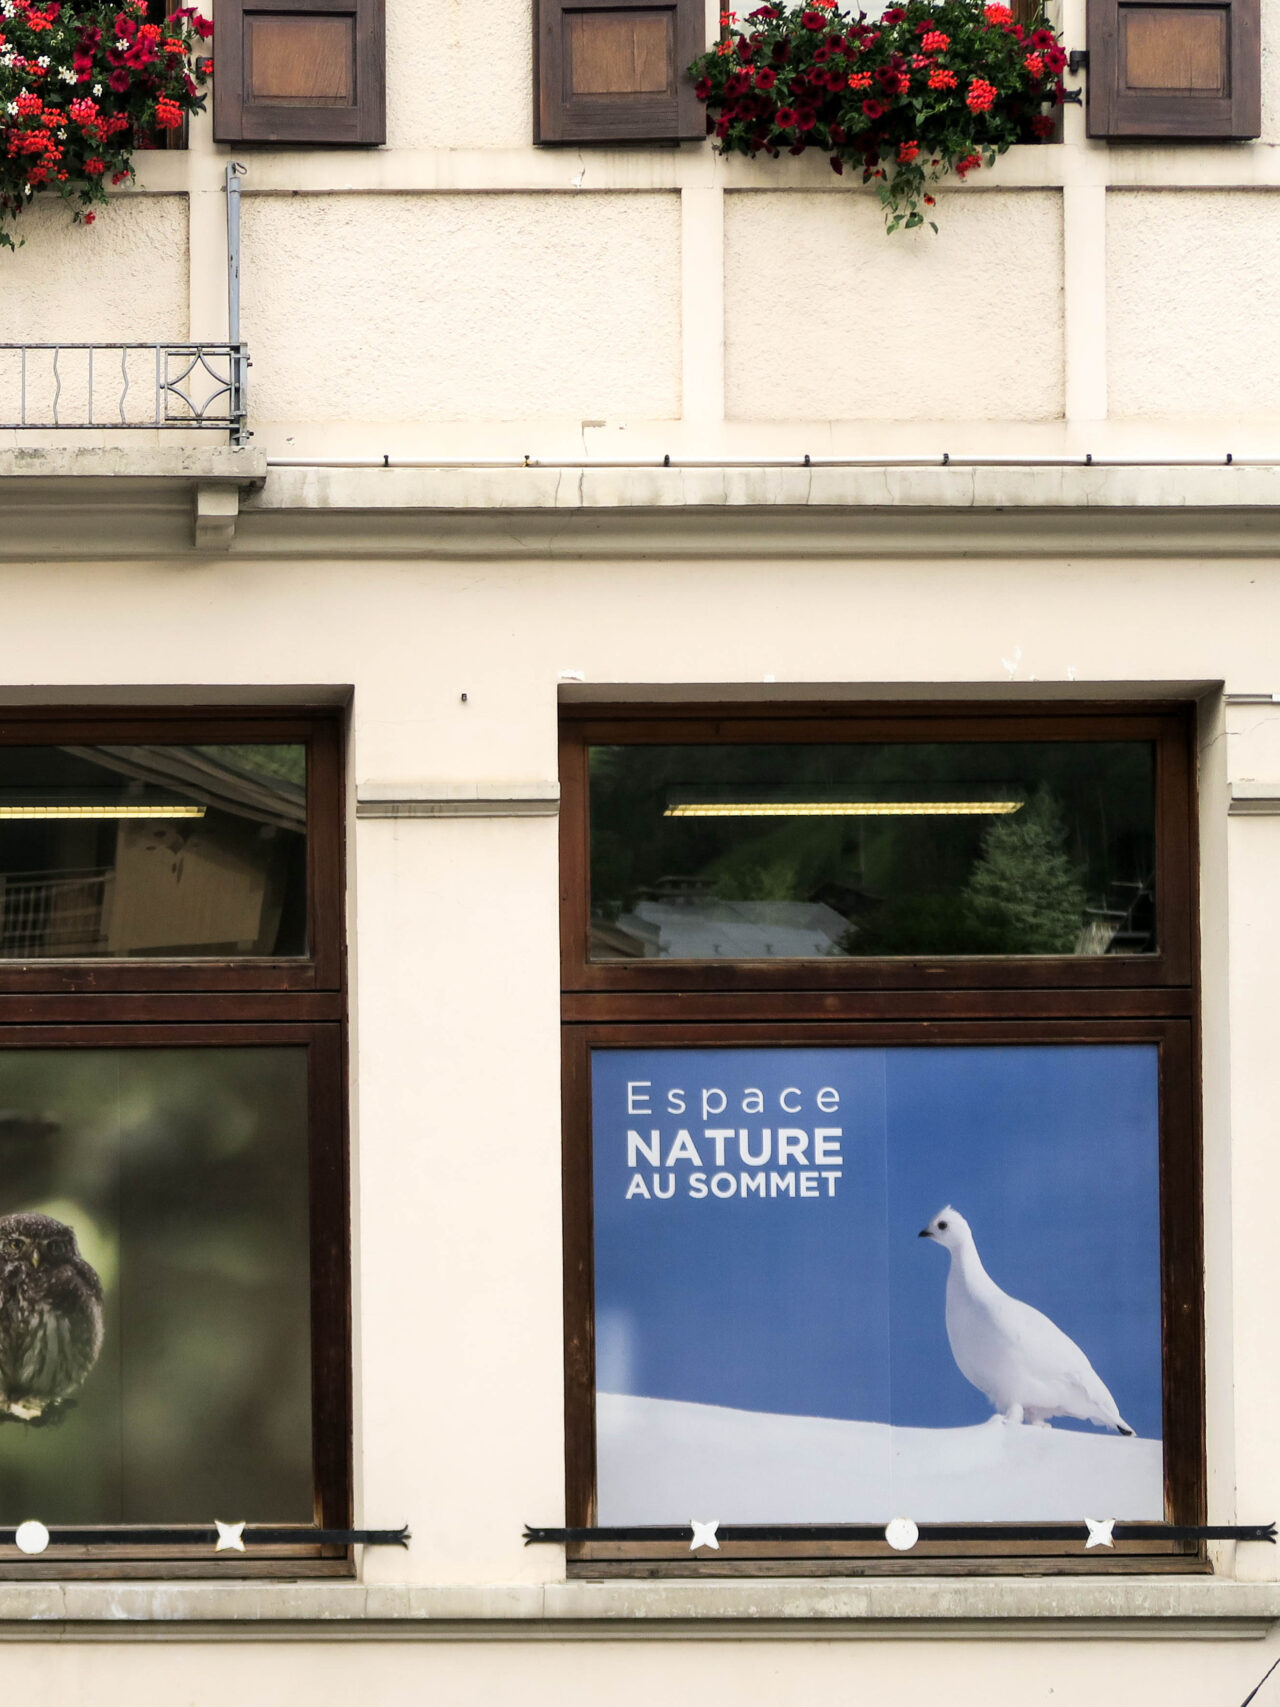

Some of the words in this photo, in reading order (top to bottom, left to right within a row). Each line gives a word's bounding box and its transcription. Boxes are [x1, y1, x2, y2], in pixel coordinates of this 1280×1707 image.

[627, 1080, 840, 1121] Espace
[627, 1128, 844, 1168] NATURE
[625, 1173, 676, 1200] AU
[688, 1171, 843, 1199] SOMMET
